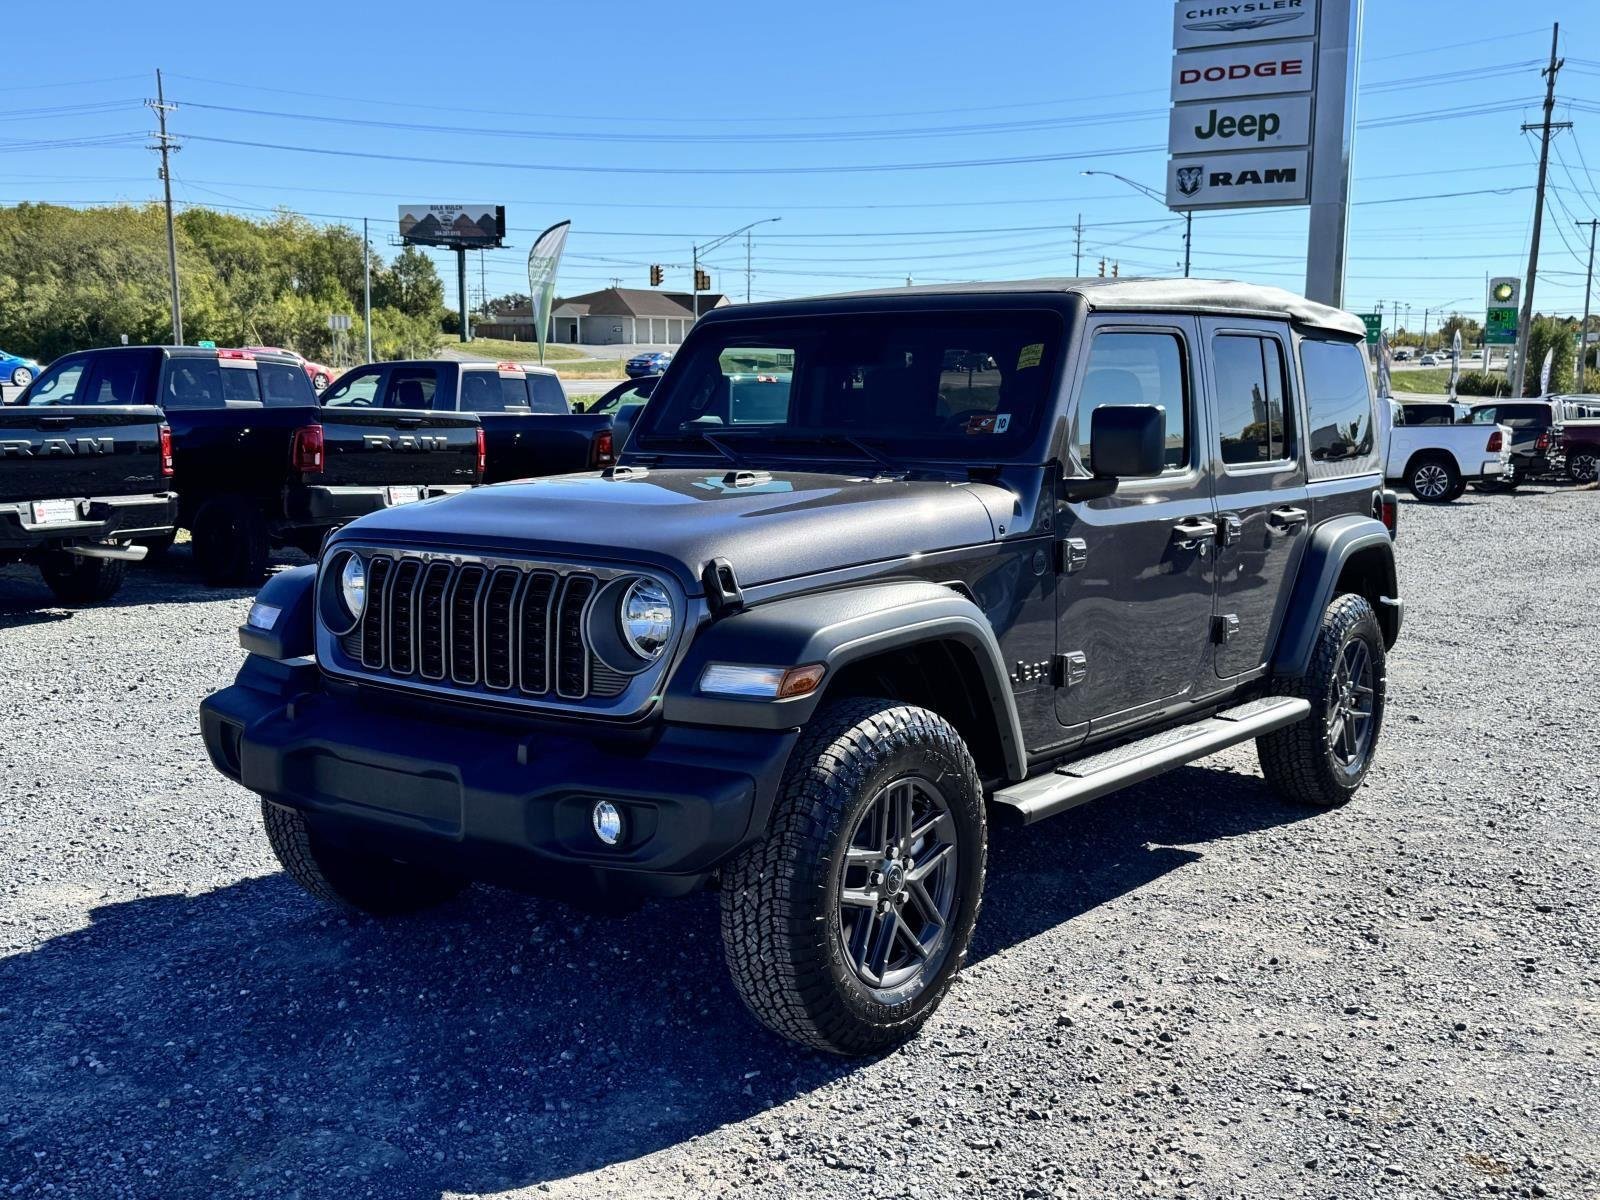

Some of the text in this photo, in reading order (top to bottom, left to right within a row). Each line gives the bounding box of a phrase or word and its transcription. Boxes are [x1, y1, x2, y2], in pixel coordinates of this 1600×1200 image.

[1185, 0, 1303, 19] CHRYSLER
[1180, 60, 1303, 85] DODGE
[1194, 109, 1280, 142] Jeep
[1209, 168, 1297, 187] RAM
[0, 437, 114, 456] RAM
[363, 435, 448, 451] RAM
[1010, 660, 1049, 684] Jeep
